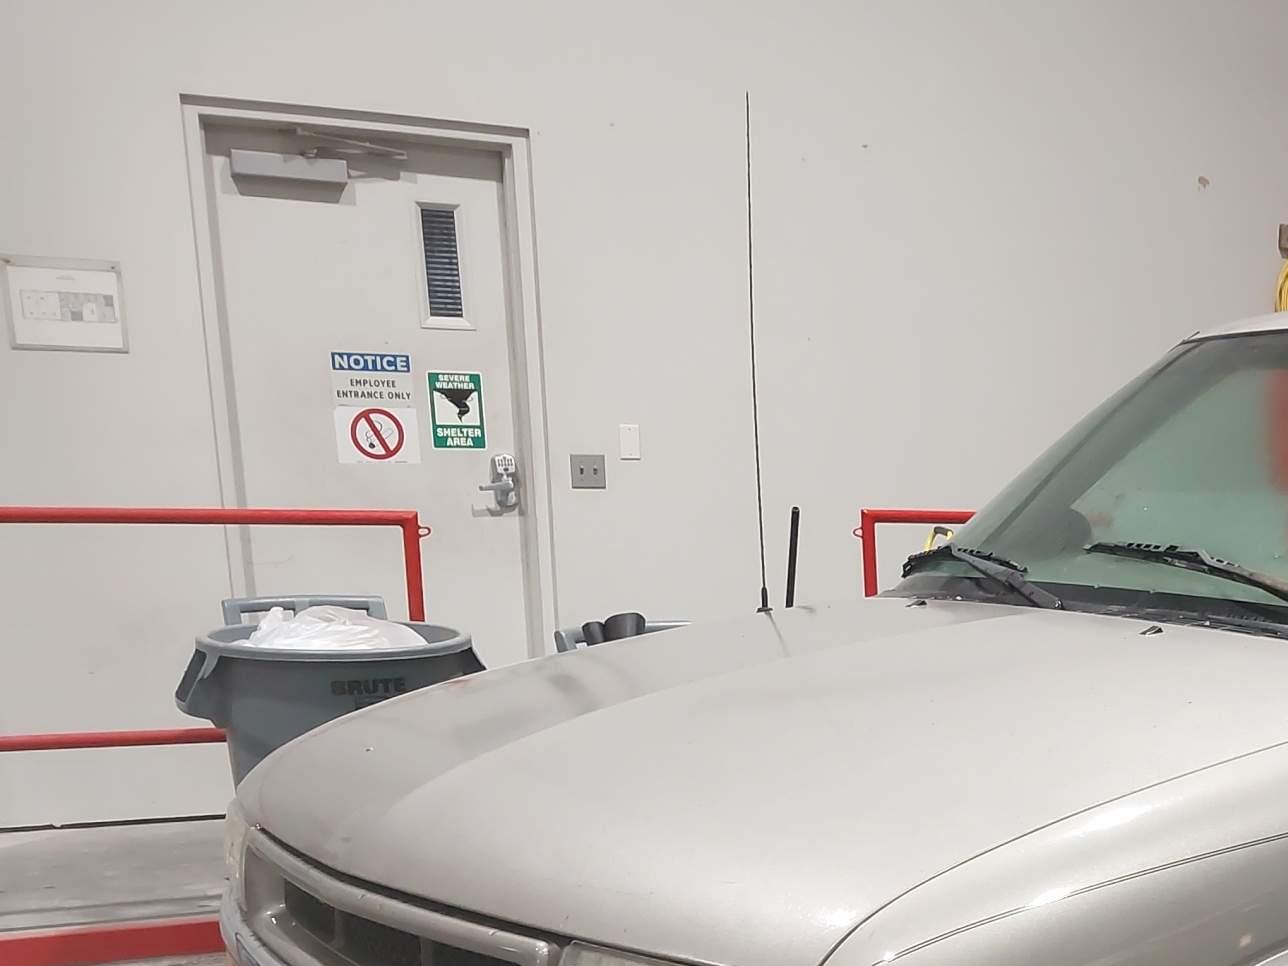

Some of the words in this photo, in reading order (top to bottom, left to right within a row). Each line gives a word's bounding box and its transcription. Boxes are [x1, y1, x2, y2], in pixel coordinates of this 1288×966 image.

[333, 354, 409, 371] NOTICE
[350, 378, 396, 388] EMPLOYEE
[438, 374, 470, 382] SEVERE
[435, 381, 475, 389] WEATHER
[337, 390, 384, 399] ENTRANCE
[388, 391, 411, 400] ONLY
[437, 427, 481, 437] SHELTER
[446, 437, 474, 446] AREA
[330, 678, 405, 696] BRUTE
